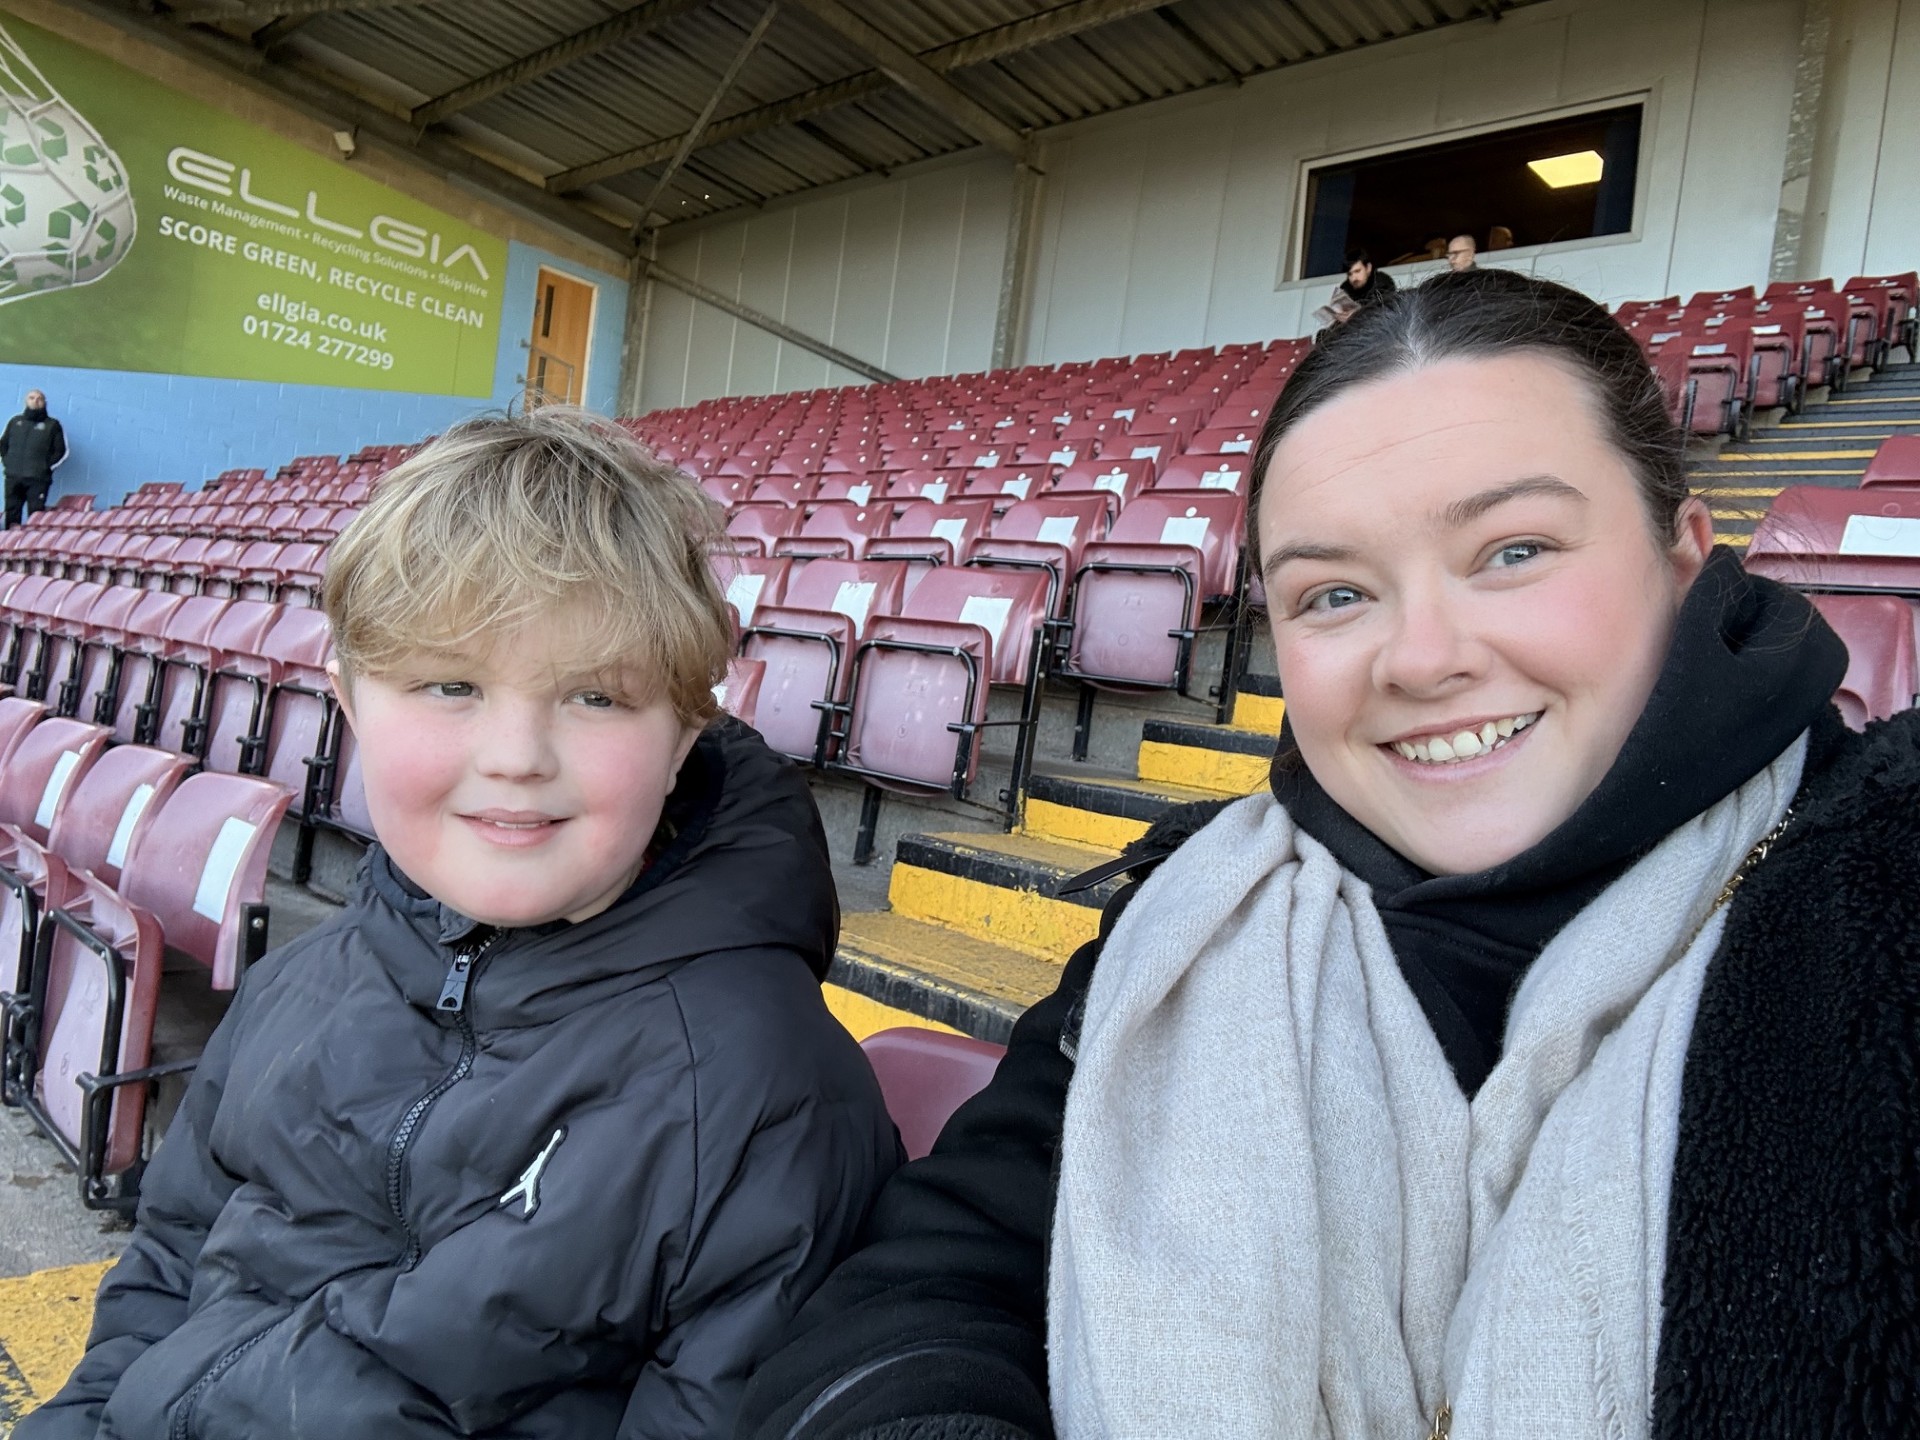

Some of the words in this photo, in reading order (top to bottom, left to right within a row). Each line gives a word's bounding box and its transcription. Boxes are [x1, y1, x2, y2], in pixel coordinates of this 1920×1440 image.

[163, 184, 208, 209] Waste
[211, 200, 301, 238] Management
[312, 231, 370, 263] Recycling
[373, 252, 428, 279] Solutions
[438, 272, 462, 292] Skip
[463, 280, 488, 297] Hire
[167, 146, 490, 281] ELLGIA
[159, 215, 237, 255] SCORE
[243, 241, 321, 283] GREEN,
[329, 269, 416, 308] RECYCLE
[421, 296, 484, 328] CLEAN
[257, 292, 387, 342] ellgia.co.uk
[243, 315, 312, 349] 01724
[317, 335, 394, 370] 277299
